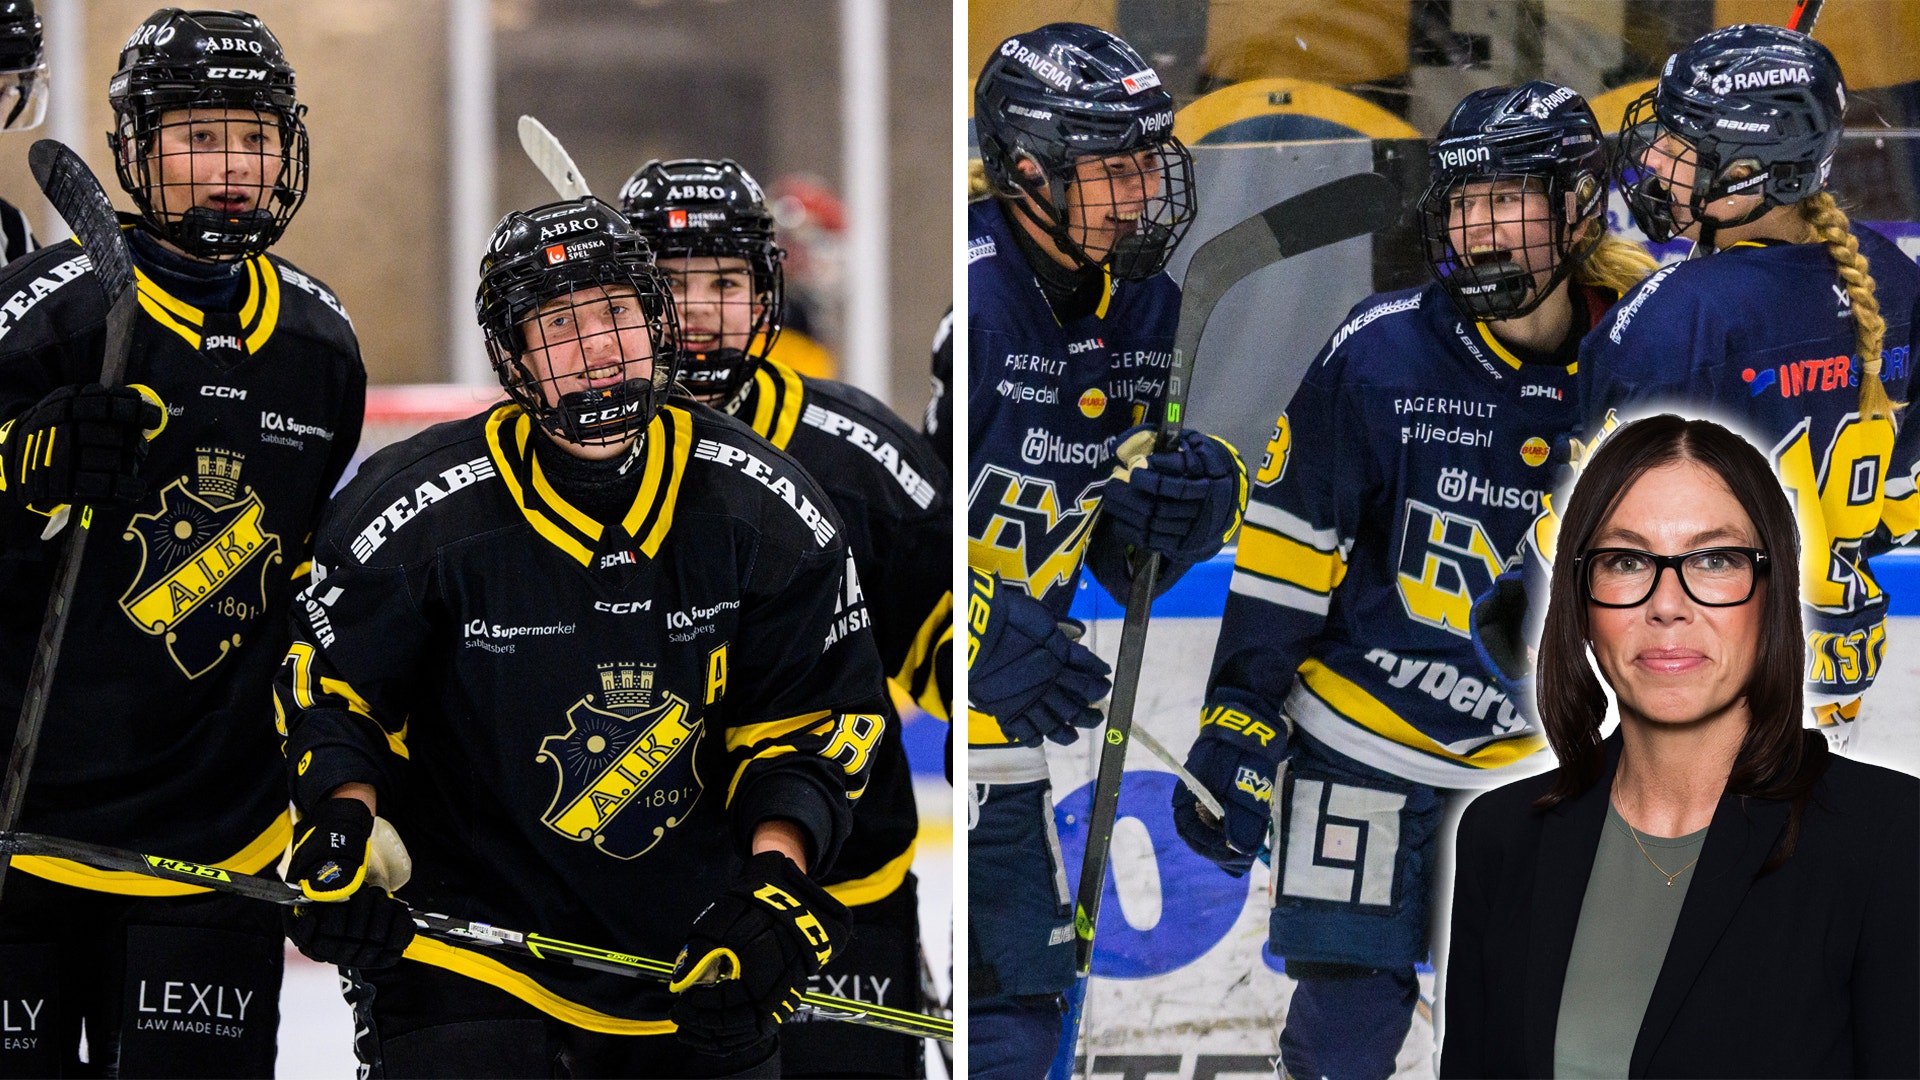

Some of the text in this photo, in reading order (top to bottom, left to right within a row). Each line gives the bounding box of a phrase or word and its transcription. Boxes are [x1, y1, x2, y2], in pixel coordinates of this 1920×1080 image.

[206, 67, 268, 81] CCM
[1014, 46, 1072, 93] RAVEMA
[1734, 68, 1811, 90] RAVEMA
[1007, 104, 1053, 121] BAUER
[1138, 110, 1174, 136] Yellon
[1716, 118, 1771, 133] BAUER
[1438, 146, 1490, 170] Yellon
[1726, 172, 1769, 194] BAUER
[566, 239, 606, 254] SVENSKA
[568, 250, 590, 261] SPEL
[1460, 335, 1503, 380] BAUER
[1780, 345, 1911, 398] INTERSORT
[200, 385, 248, 401] CCM
[579, 401, 640, 424] CCM
[1394, 397, 1497, 418] FAGERHULT
[261, 411, 285, 431] ICA
[822, 409, 923, 500] PEAB
[714, 442, 821, 534] PEAB
[361, 461, 478, 552] PEAB
[594, 599, 652, 614] CCM
[464, 619, 577, 639] ICA Supermarket
[667, 611, 693, 630] ICA
[703, 640, 729, 708] A
[139, 980, 253, 1020] LEXLY
[137, 1018, 244, 1039] LAW MADE EASY
[4, 1038, 38, 1049] EASY
